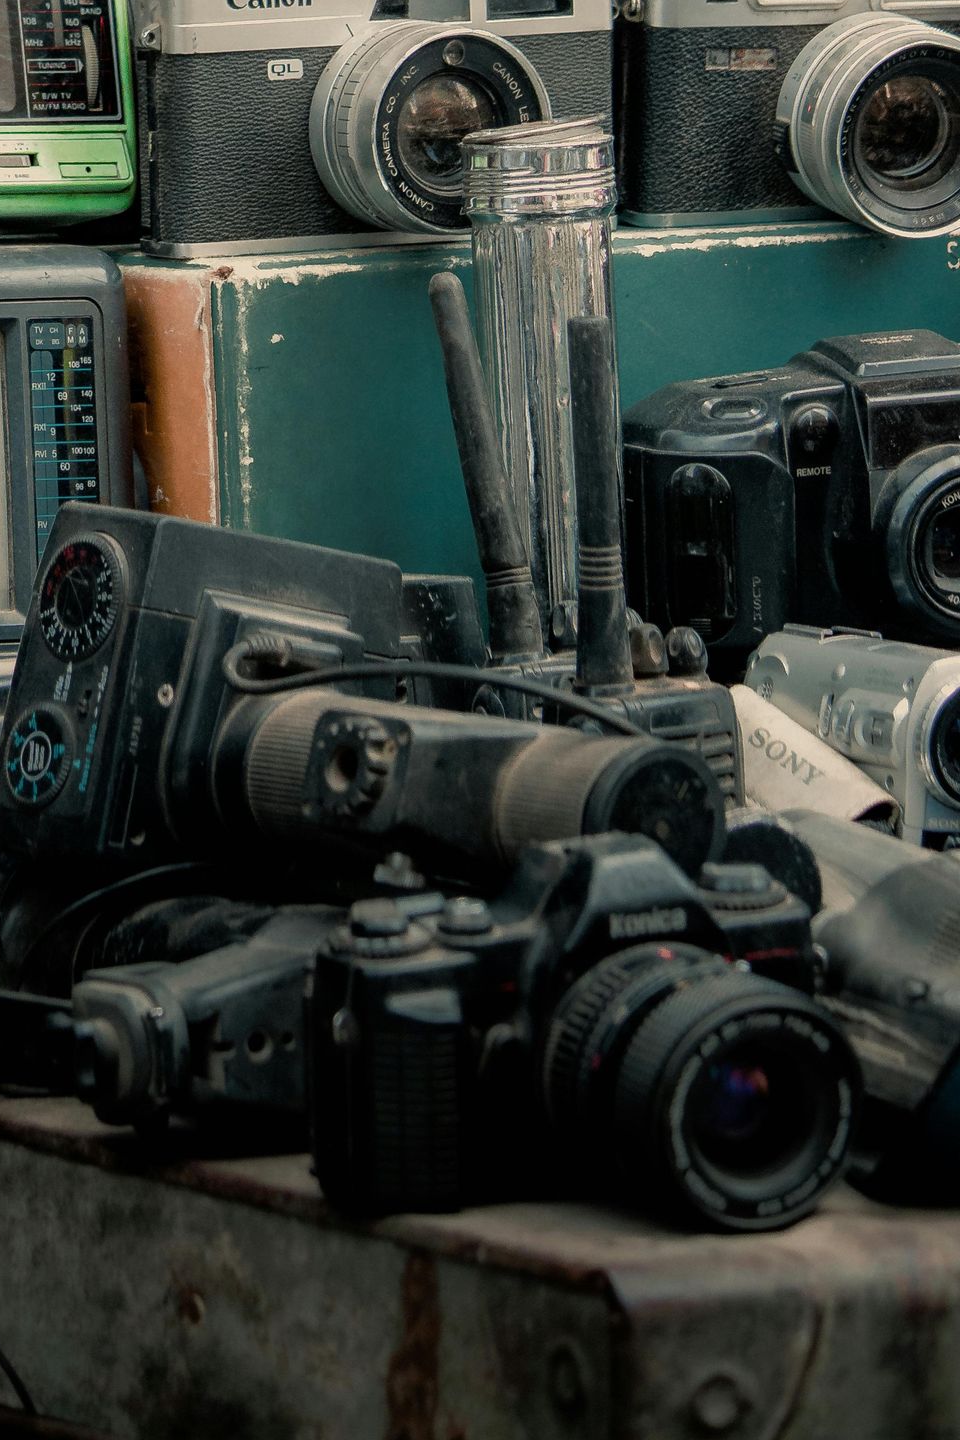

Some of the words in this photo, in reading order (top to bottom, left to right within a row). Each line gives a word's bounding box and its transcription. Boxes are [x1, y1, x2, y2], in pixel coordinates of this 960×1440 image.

[23, 17, 36, 25] 108
[65, 18, 79, 26] 160
[271, 64, 299, 76] QL
[492, 62, 524, 100] CANON
[518, 106, 529, 123] LE
[382, 123, 398, 177] CAMERA
[399, 181, 434, 212] CANON
[46, 373, 56, 381] 12
[58, 392, 67, 400] 69
[50, 428, 56, 436] 9
[51, 450, 57, 458] 5
[60, 463, 70, 471] 60
[796, 466, 831, 478] REMOTE
[752, 576, 762, 621] PUSH
[748, 727, 824, 786] SONY
